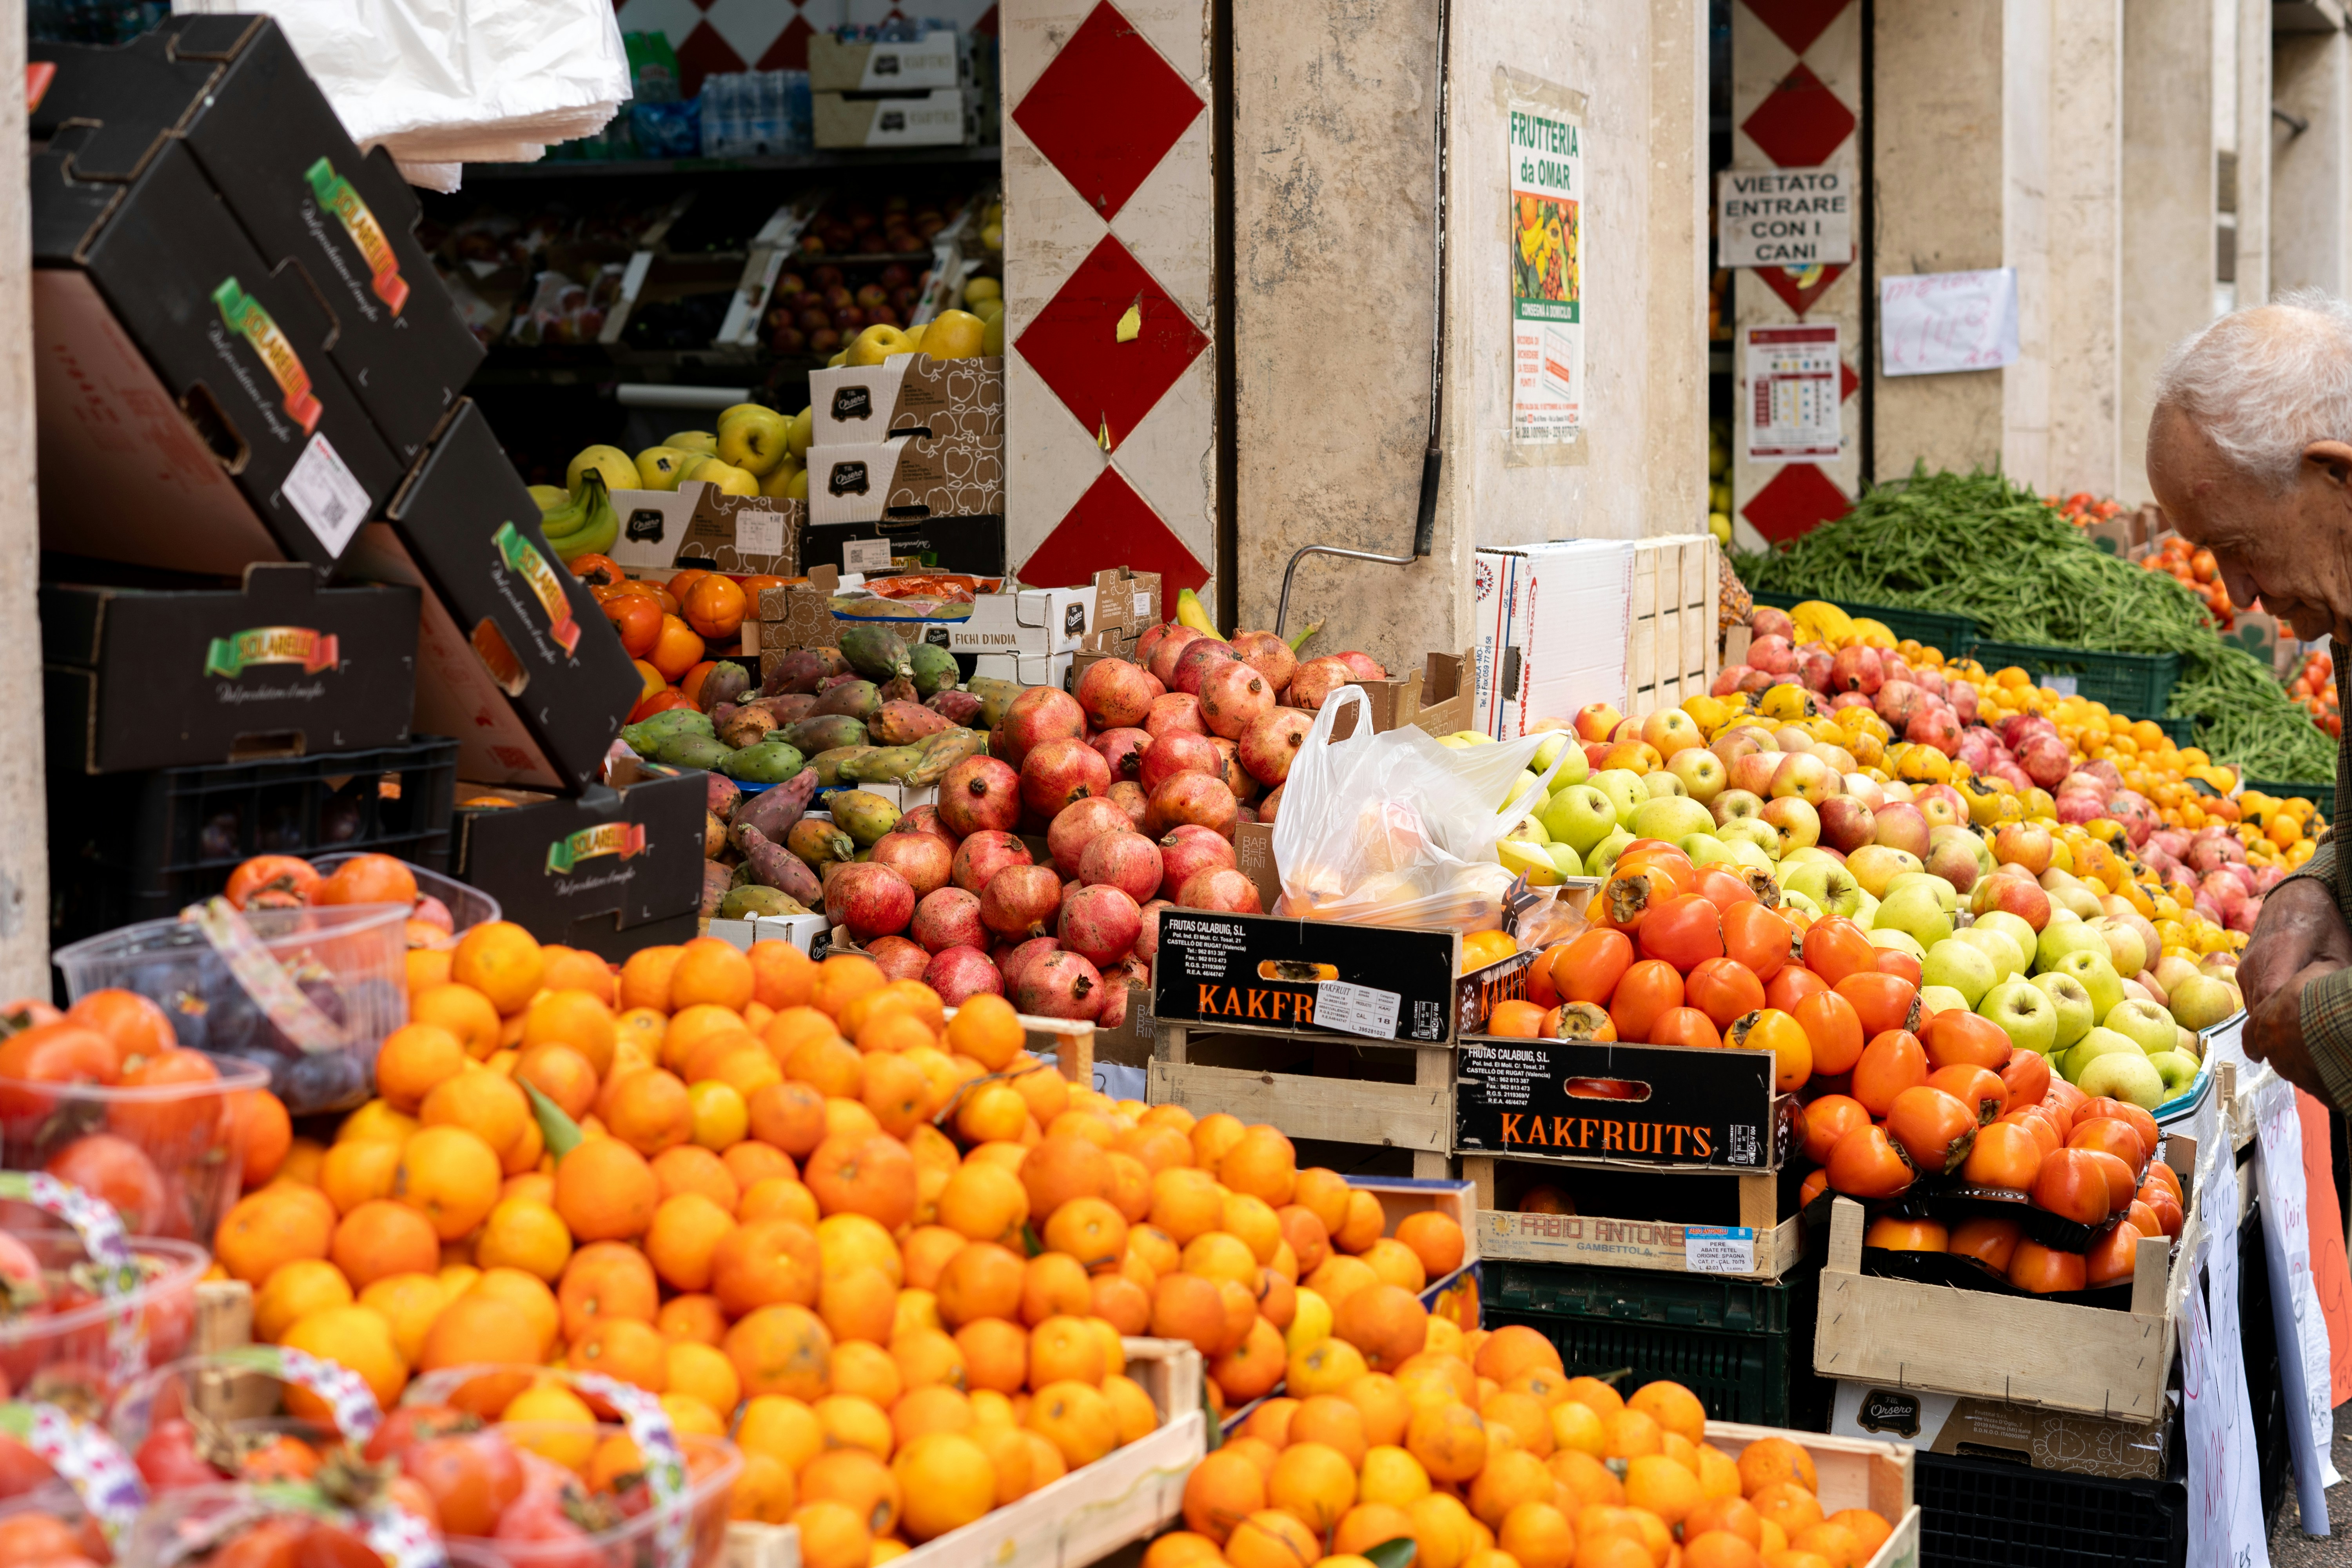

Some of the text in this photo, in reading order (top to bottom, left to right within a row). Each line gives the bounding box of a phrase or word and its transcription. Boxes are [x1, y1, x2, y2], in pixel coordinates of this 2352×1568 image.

[1512, 111, 1578, 158] FRUTTERIA
[1521, 156, 1570, 191] da OMAR
[1733, 174, 1838, 193] VIETATO
[1726, 196, 1846, 216] ENTRARE
[333, 186, 392, 274] SOLARELLI
[1751, 220, 1820, 239] CON I
[1755, 243, 1816, 261] CANI
[1546, 305, 1572, 319] A DOMICILIO
[242, 306, 304, 394] SOLARELLI
[838, 395, 866, 410] Orsero
[836, 470, 863, 484] Orsero
[518, 544, 570, 620] SOLARELLI
[1067, 611, 1083, 626] Orsero
[238, 633, 312, 661] SOLARELLI
[955, 633, 1016, 645] FICHI D'INDIA
[1486, 636, 1492, 644] 58
[1431, 709, 1448, 726] TENUTA
[1502, 724, 1507, 733] 8%
[572, 828, 624, 856] SOLARELLI
[1169, 919, 1246, 936] FRUTAS CALABUIG, S.L.
[1223, 944, 1246, 952] (Valencia)
[1319, 982, 1351, 996] KAKFRUIT
[1197, 984, 1313, 1023] KAKFR
[1359, 1027, 1386, 1036] 395281023
[1468, 1047, 1550, 1063] FRUTAS CALABUIG, S.L.
[1500, 1112, 1711, 1157] KAKFRUITS
[1521, 1214, 1584, 1239] FABIO
[1577, 1242, 1651, 1255] GAMBETTOLA
[1870, 1404, 1913, 1416] Orsero
[1999, 1419, 2018, 1427] D'Oglio,
[1973, 1428, 2029, 1440] B.D.N.O.O. ITA0003965
